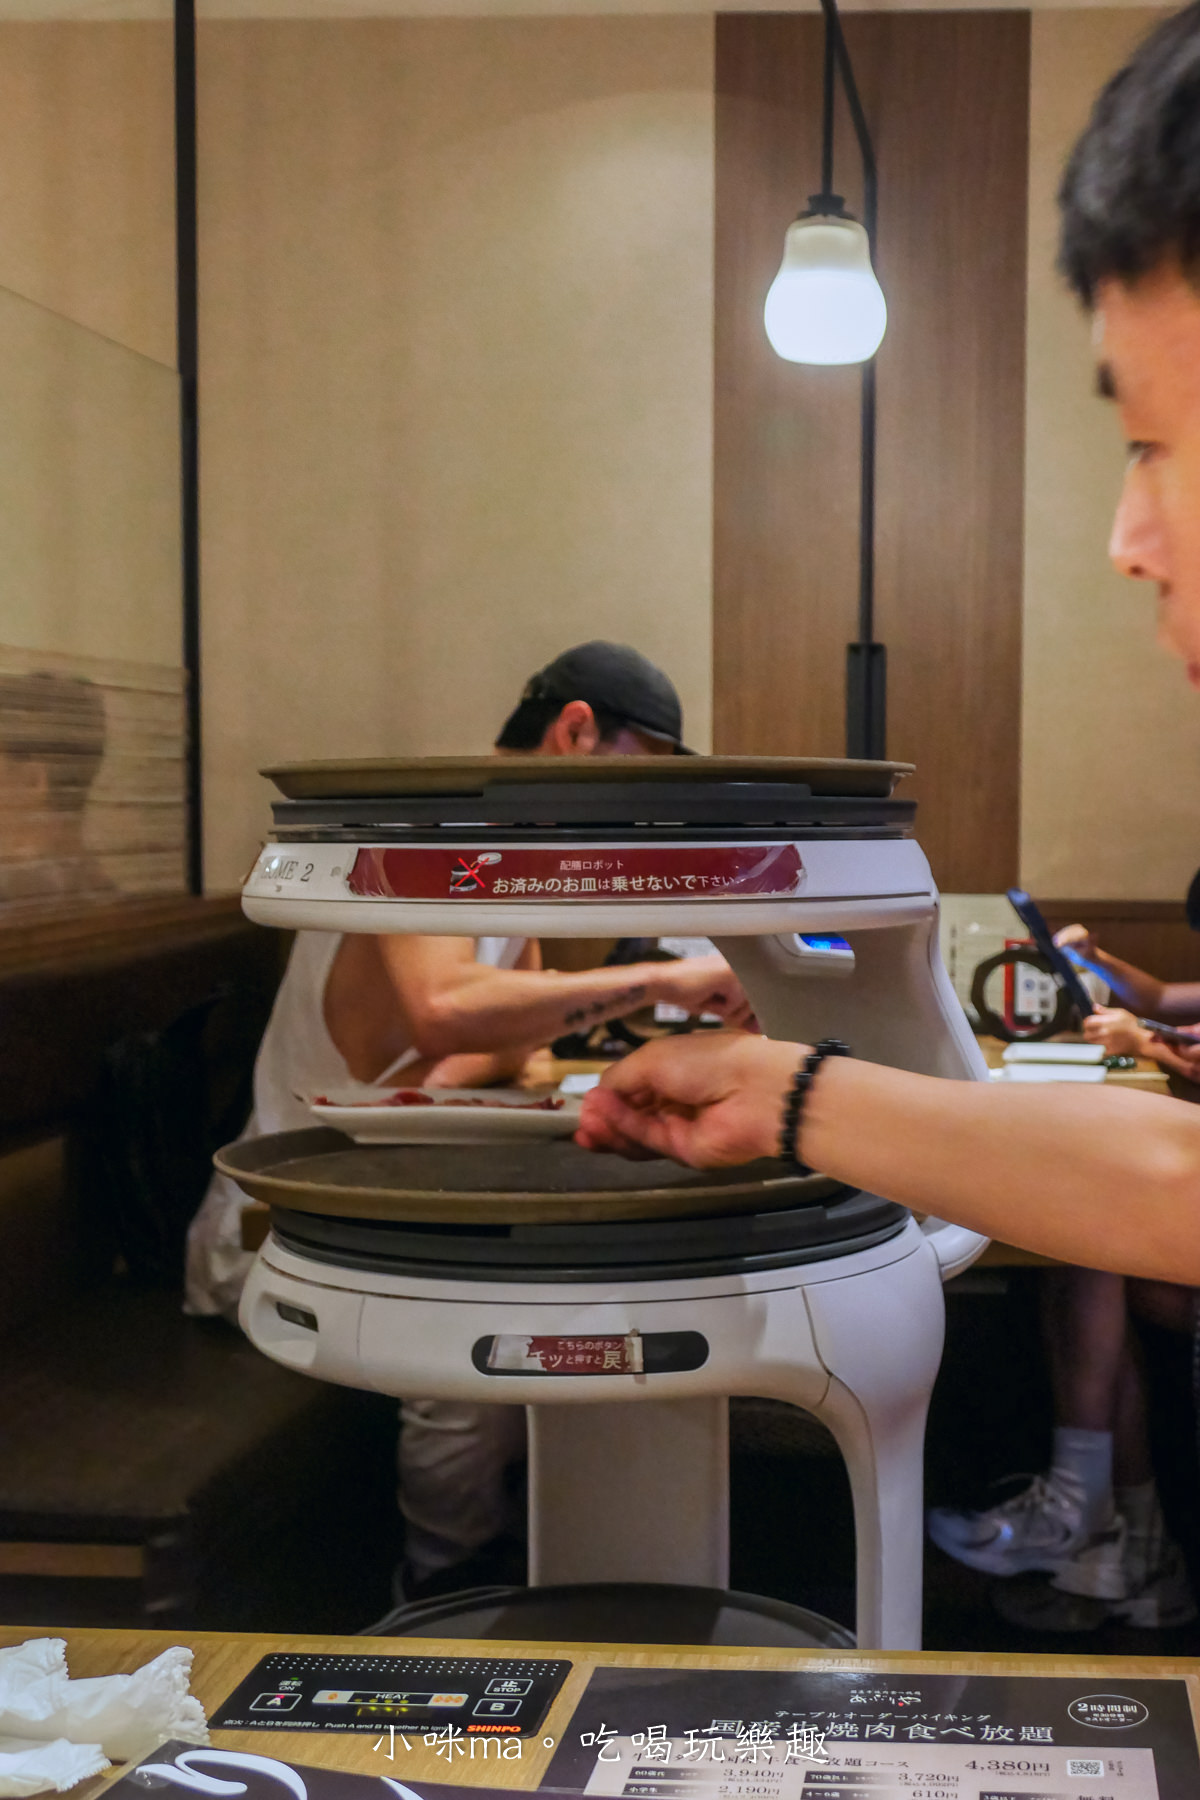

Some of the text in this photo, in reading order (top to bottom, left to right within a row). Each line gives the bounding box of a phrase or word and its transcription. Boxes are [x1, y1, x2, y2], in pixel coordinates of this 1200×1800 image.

[300, 862, 314, 882] 2
[492, 874, 735, 894] お済みのお皿は乗せないで下さい
[500, 1680, 519, 1688] 止
[375, 1692, 410, 1700] HEAT
[266, 1697, 282, 1706] A
[489, 1702, 506, 1712] B
[383, 1723, 418, 1732] toether
[466, 1724, 522, 1733] SHINPO
[964, 1759, 1050, 1772] 4,380円
[723, 1768, 784, 1779] 3,940円
[898, 1772, 960, 1783] 3,720円
[717, 1785, 781, 1796] 2,190円
[912, 1789, 959, 1800] 610円
